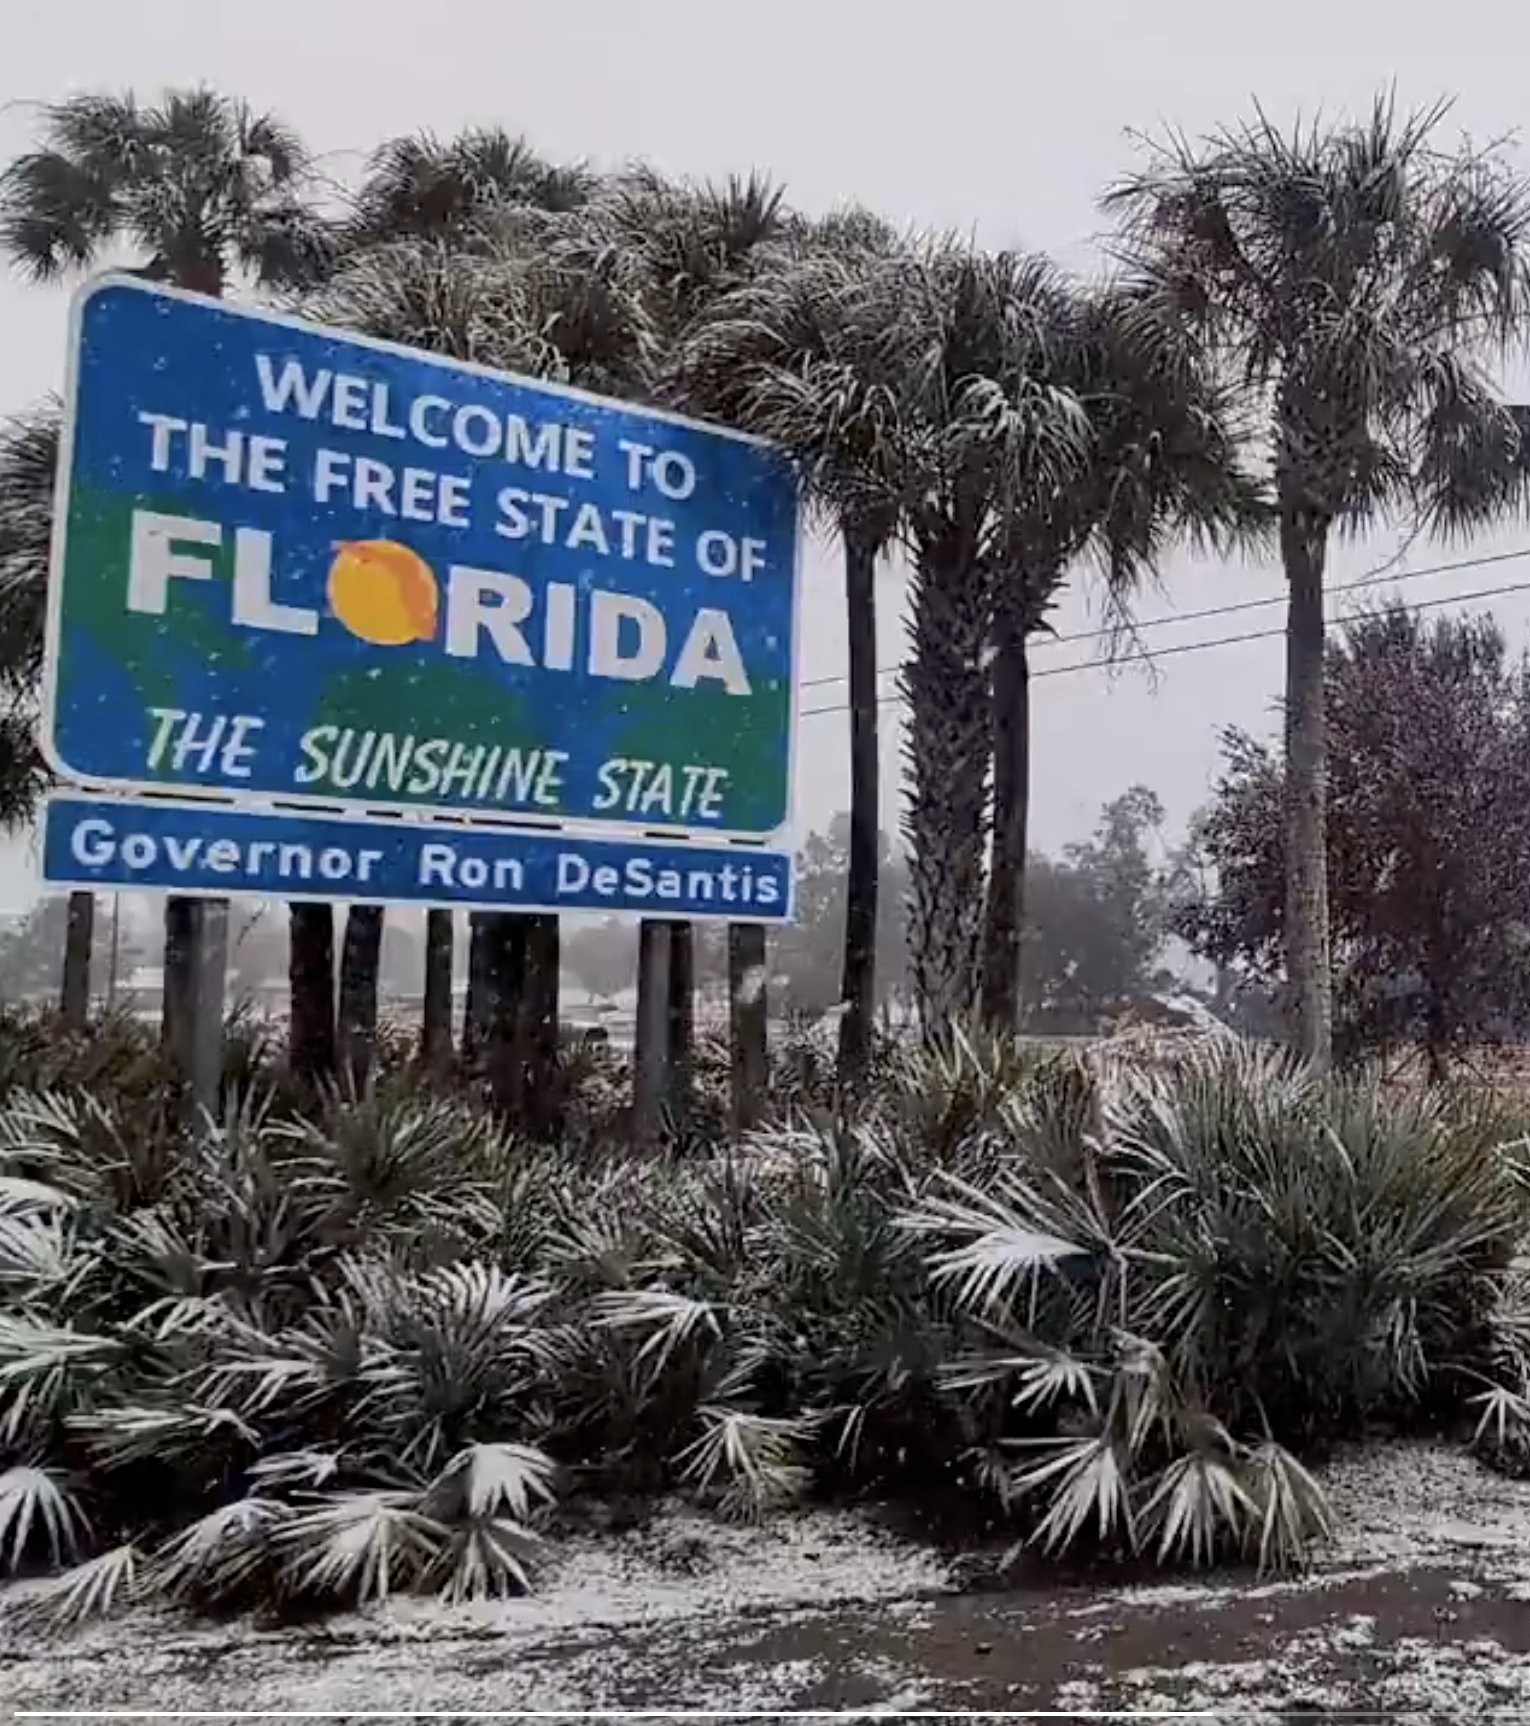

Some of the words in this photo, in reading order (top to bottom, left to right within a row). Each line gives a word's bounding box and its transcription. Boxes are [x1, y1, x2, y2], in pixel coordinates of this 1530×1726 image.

[139, 413, 284, 491] THE
[315, 451, 470, 527] FREE
[496, 489, 675, 567] STATE
[697, 531, 766, 581] OF
[256, 354, 594, 479] WELCOME
[620, 439, 696, 500] TO
[125, 511, 752, 695] FLORIDA
[145, 708, 263, 777] THE
[295, 725, 568, 804] SUNSHINE
[593, 758, 728, 818] STATE
[71, 820, 383, 881] Governor
[420, 844, 523, 889] Ron
[556, 854, 779, 902] DeSantis
